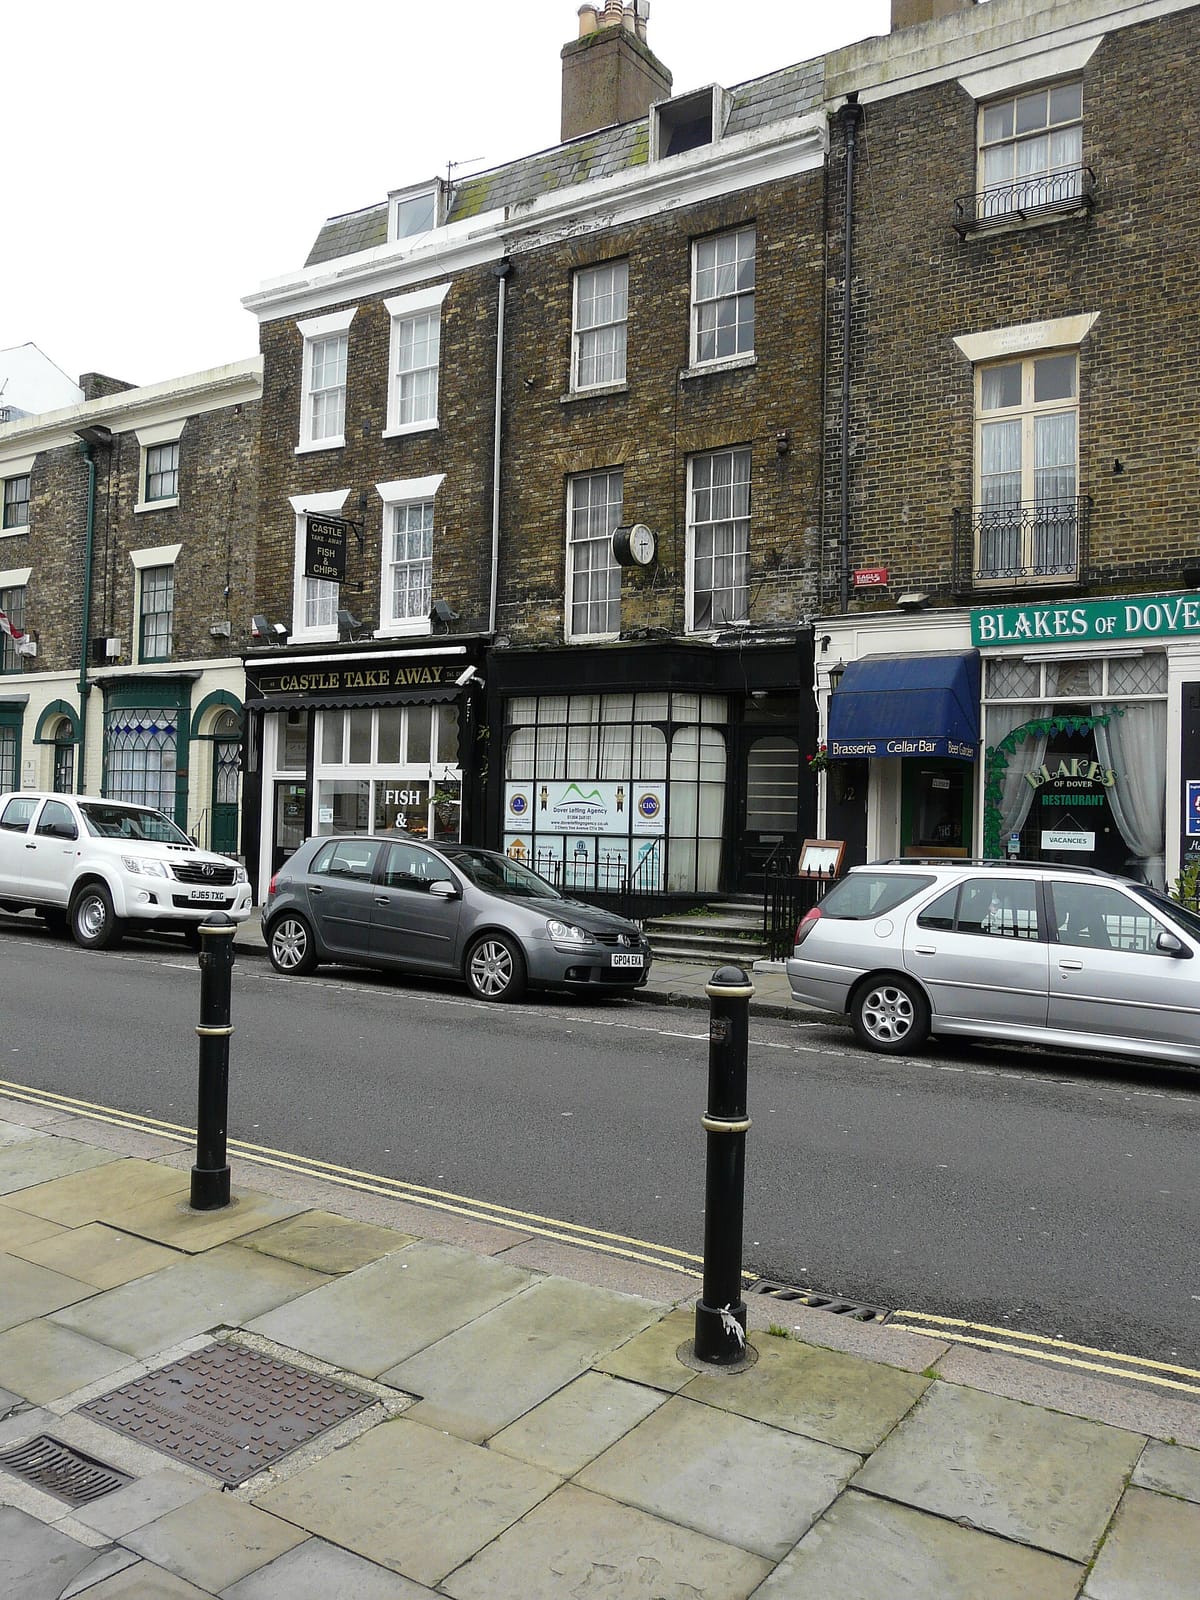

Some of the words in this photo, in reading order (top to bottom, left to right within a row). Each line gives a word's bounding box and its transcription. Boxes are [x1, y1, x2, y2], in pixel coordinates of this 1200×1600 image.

[311, 523, 343, 537] CASTLE
[311, 534, 325, 542] TAKE
[317, 546, 336, 558] FISH
[322, 557, 329, 566] &
[313, 564, 338, 577] CHIPS
[978, 609, 1089, 641] BLAKES
[1095, 616, 1117, 634] OF
[1124, 597, 1200, 632] DOVE
[280, 672, 340, 691] CASTLE
[344, 668, 390, 687] TAKE
[394, 665, 443, 685] AWAY
[832, 742, 876, 755] Brasserie
[886, 741, 918, 753] Cellar
[918, 740, 937, 752] Bar
[947, 741, 959, 754] Beer
[1024, 758, 1120, 790] BLAKES
[1053, 780, 1065, 788] OF
[1066, 780, 1093, 788] DOVER
[385, 790, 420, 805] FISH
[1042, 794, 1105, 806] RESTAURANT
[395, 812, 408, 828] &
[191, 890, 210, 899] GJ65
[211, 891, 225, 900] TXG
[614, 955, 631, 966] GP04
